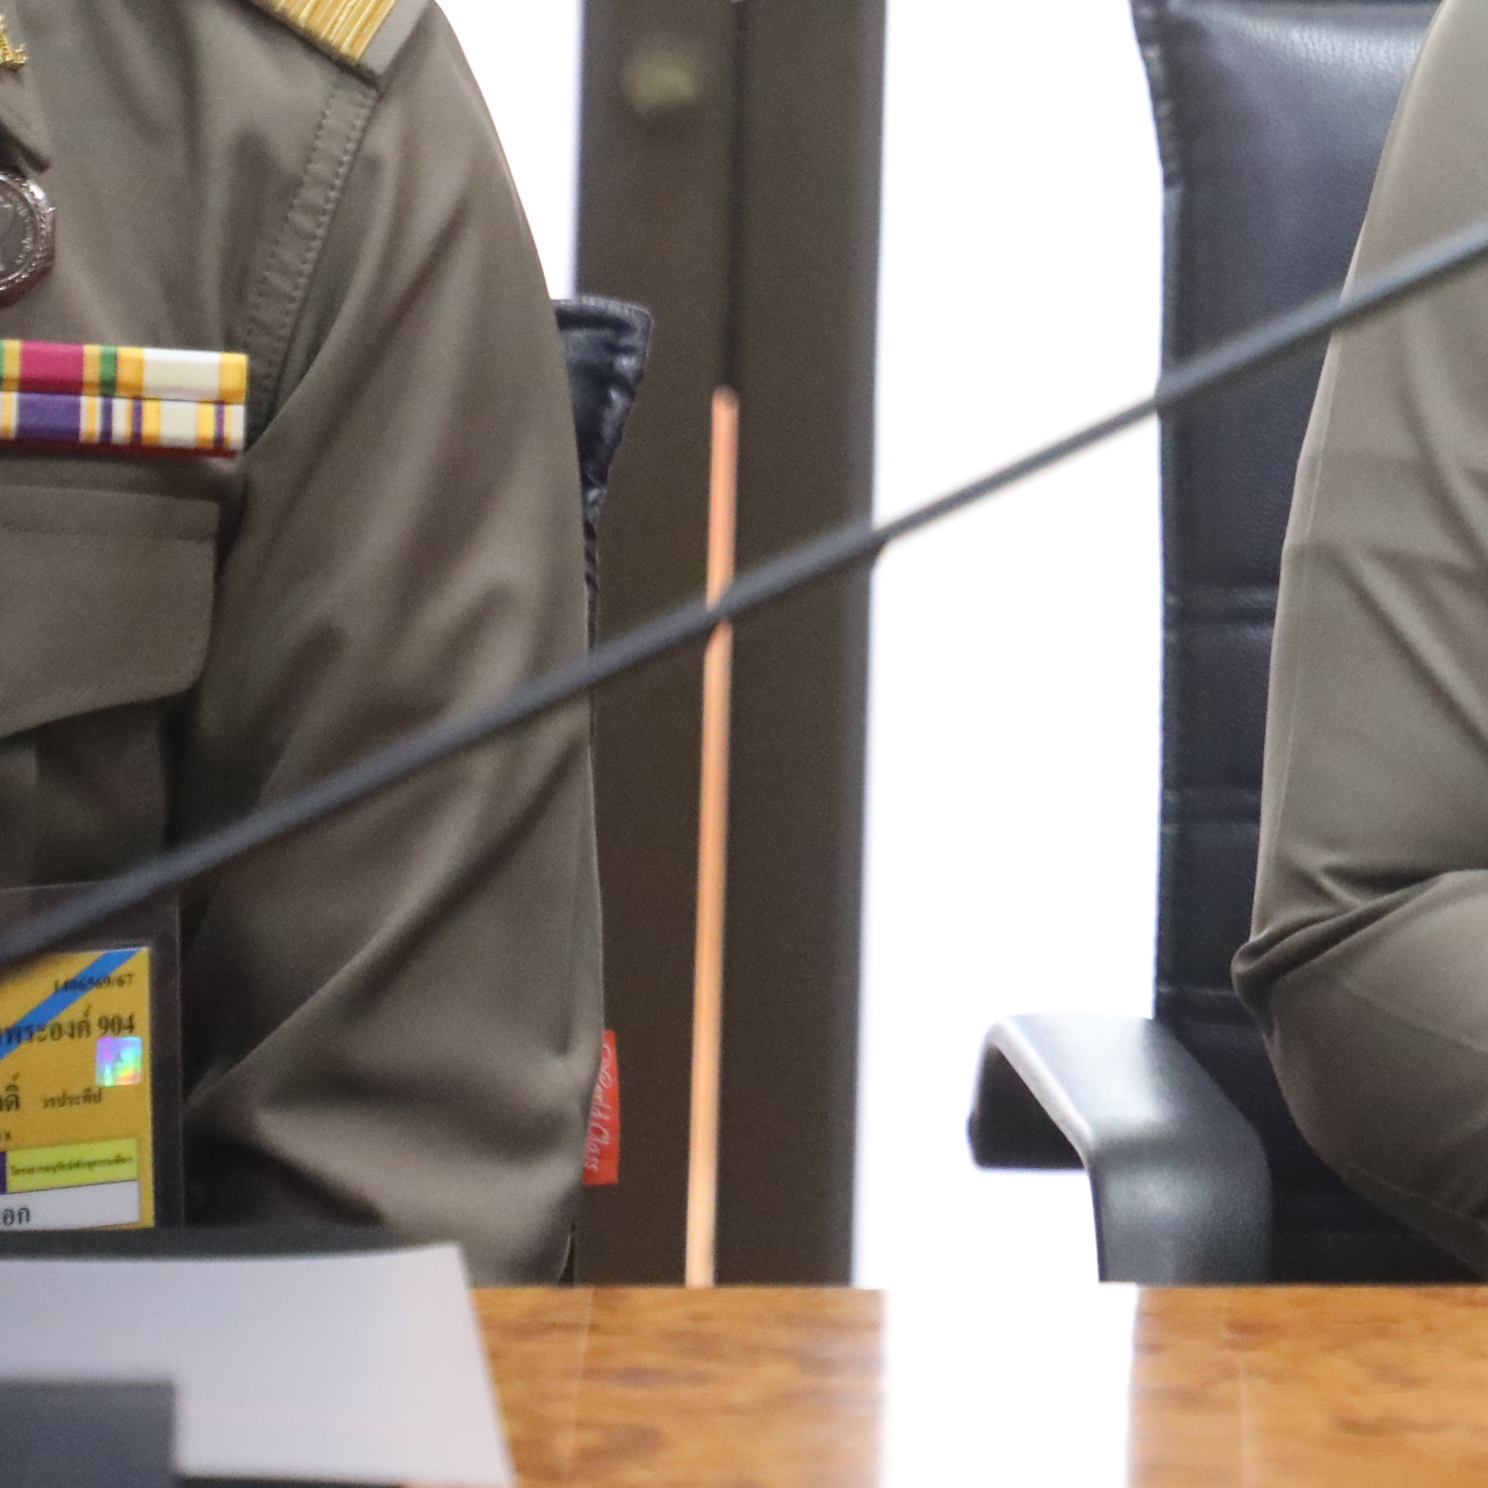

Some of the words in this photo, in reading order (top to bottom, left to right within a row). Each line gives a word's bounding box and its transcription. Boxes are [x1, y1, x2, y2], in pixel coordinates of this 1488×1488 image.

[0, 1002, 92, 1044] พระองค์
[98, 1014, 136, 1035] 904
[2, 1206, 31, 1226] อก
